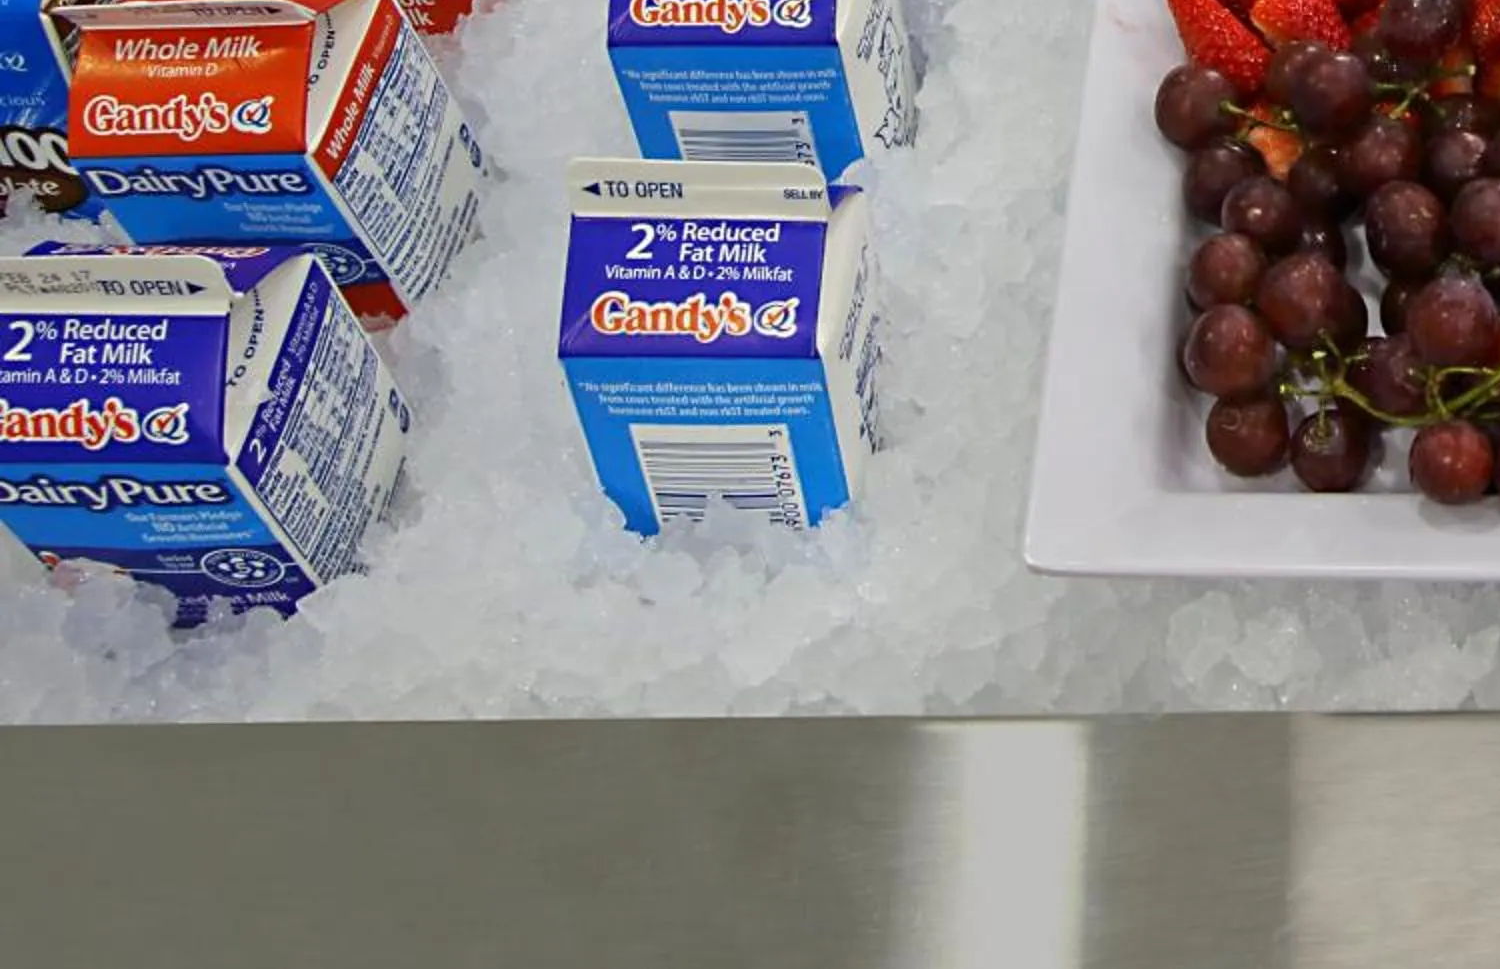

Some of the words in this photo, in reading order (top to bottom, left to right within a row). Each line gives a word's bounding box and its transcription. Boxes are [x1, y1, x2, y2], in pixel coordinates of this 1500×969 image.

[114, 38, 200, 63] Whole
[203, 36, 262, 59] Milk
[145, 63, 203, 79] Vitamin
[204, 62, 219, 77] D
[83, 91, 229, 142] Gandy's
[326, 107, 363, 162] Whole
[351, 61, 377, 112] Milk
[86, 168, 309, 200] DairyPure
[604, 180, 630, 199] TO
[634, 181, 684, 200] OPEN
[783, 188, 808, 201] SELL
[625, 222, 677, 261] 2%
[682, 222, 782, 244] Reduced
[678, 243, 714, 263] Fat
[717, 243, 768, 264] Milk
[604, 264, 663, 281] Vitamin
[663, 265, 678, 280] A
[678, 265, 693, 280] &
[692, 265, 706, 280] D
[716, 265, 742, 281] 2%
[742, 265, 794, 282] Milkfat
[100, 280, 126, 297] TO
[130, 279, 184, 297] OPEN
[591, 290, 752, 344] Gandy's
[3, 320, 58, 363] 2%
[63, 318, 169, 342] Reduced
[59, 342, 98, 366] Fat
[101, 342, 154, 366] Milk
[0, 369, 41, 385] tamin
[45, 368, 60, 384] A
[59, 368, 73, 384] &
[74, 368, 88, 384] D
[99, 368, 126, 385] 2%
[126, 368, 182, 385] Milkfat
